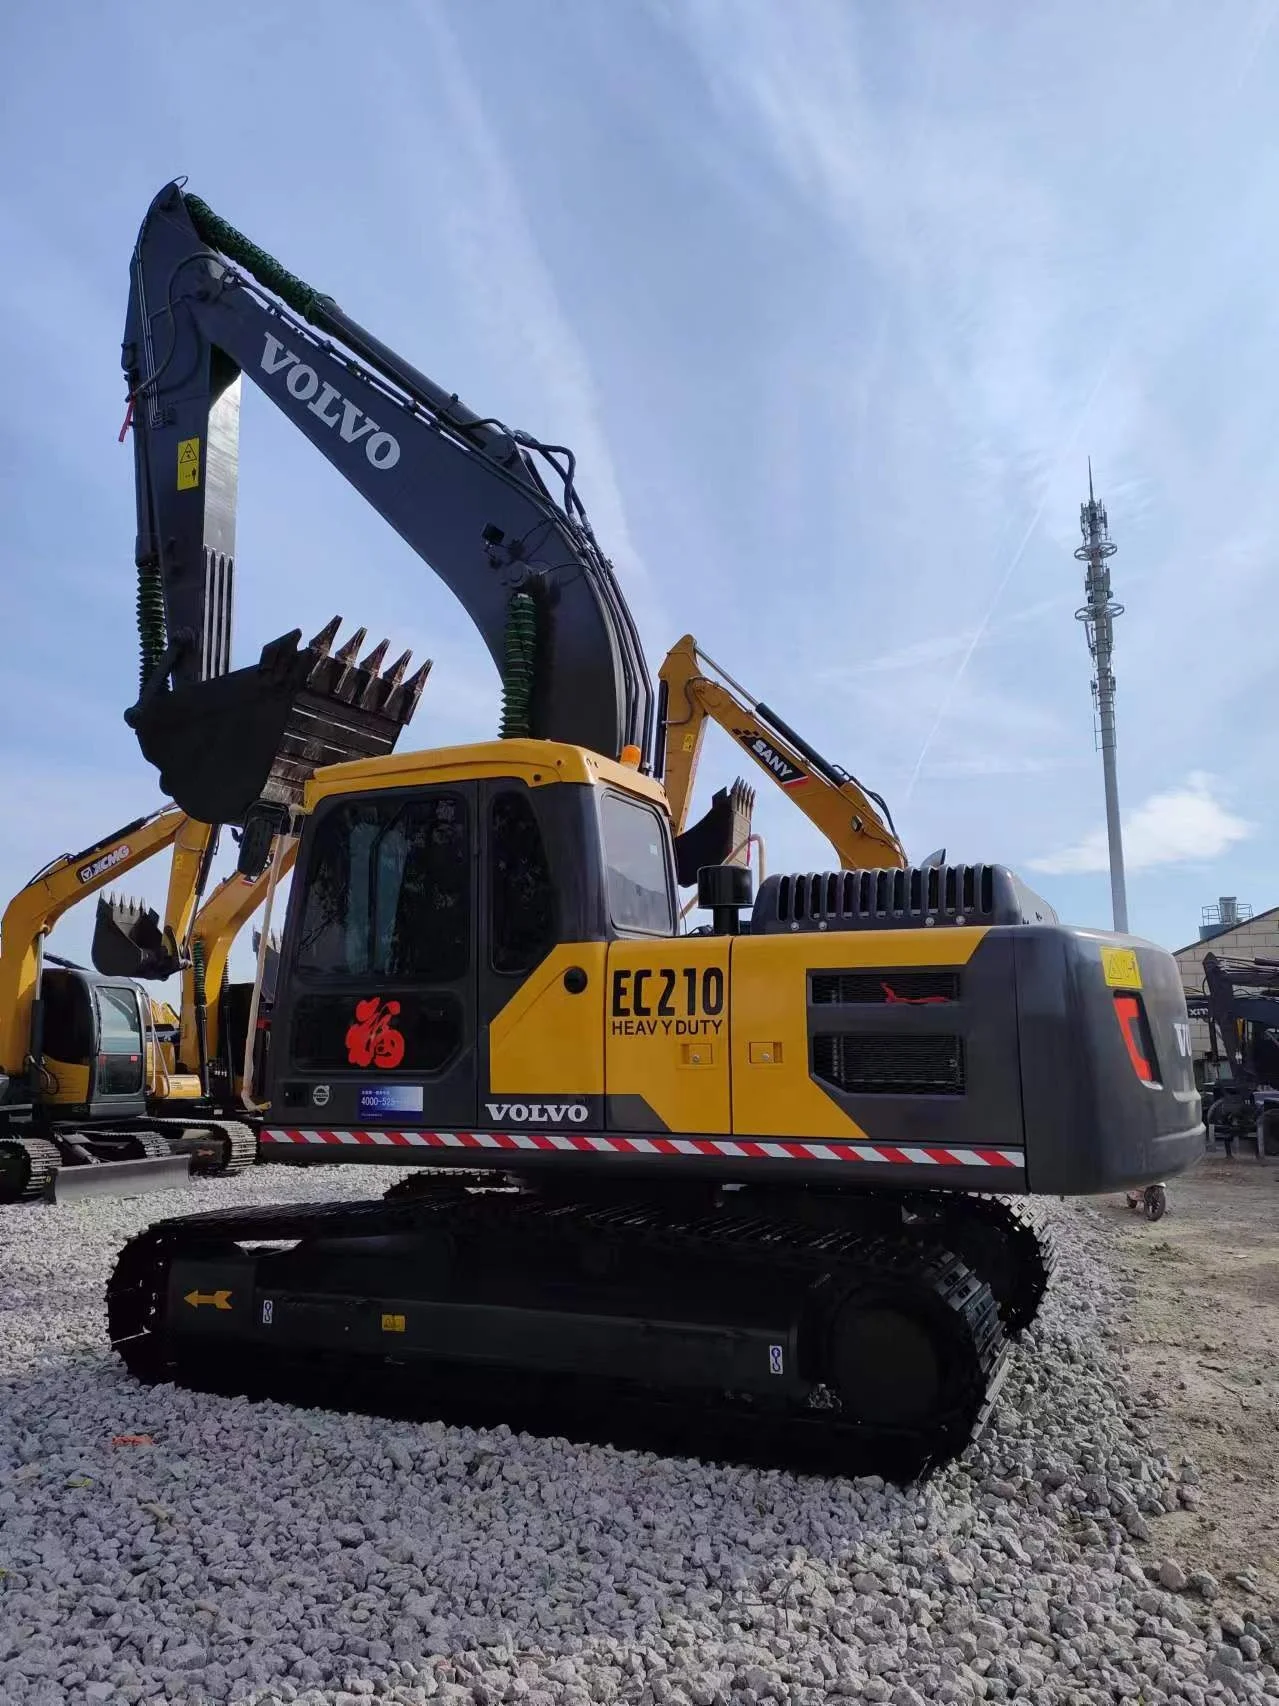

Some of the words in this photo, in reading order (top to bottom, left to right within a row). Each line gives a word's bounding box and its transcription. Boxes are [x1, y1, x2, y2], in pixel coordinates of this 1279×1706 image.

[260, 331, 401, 470] VOLVO
[752, 740, 793, 777] SANY
[91, 845, 130, 876] XCMG
[612, 967, 724, 1017] EC210
[484, 1103, 589, 1123] VOLVO
